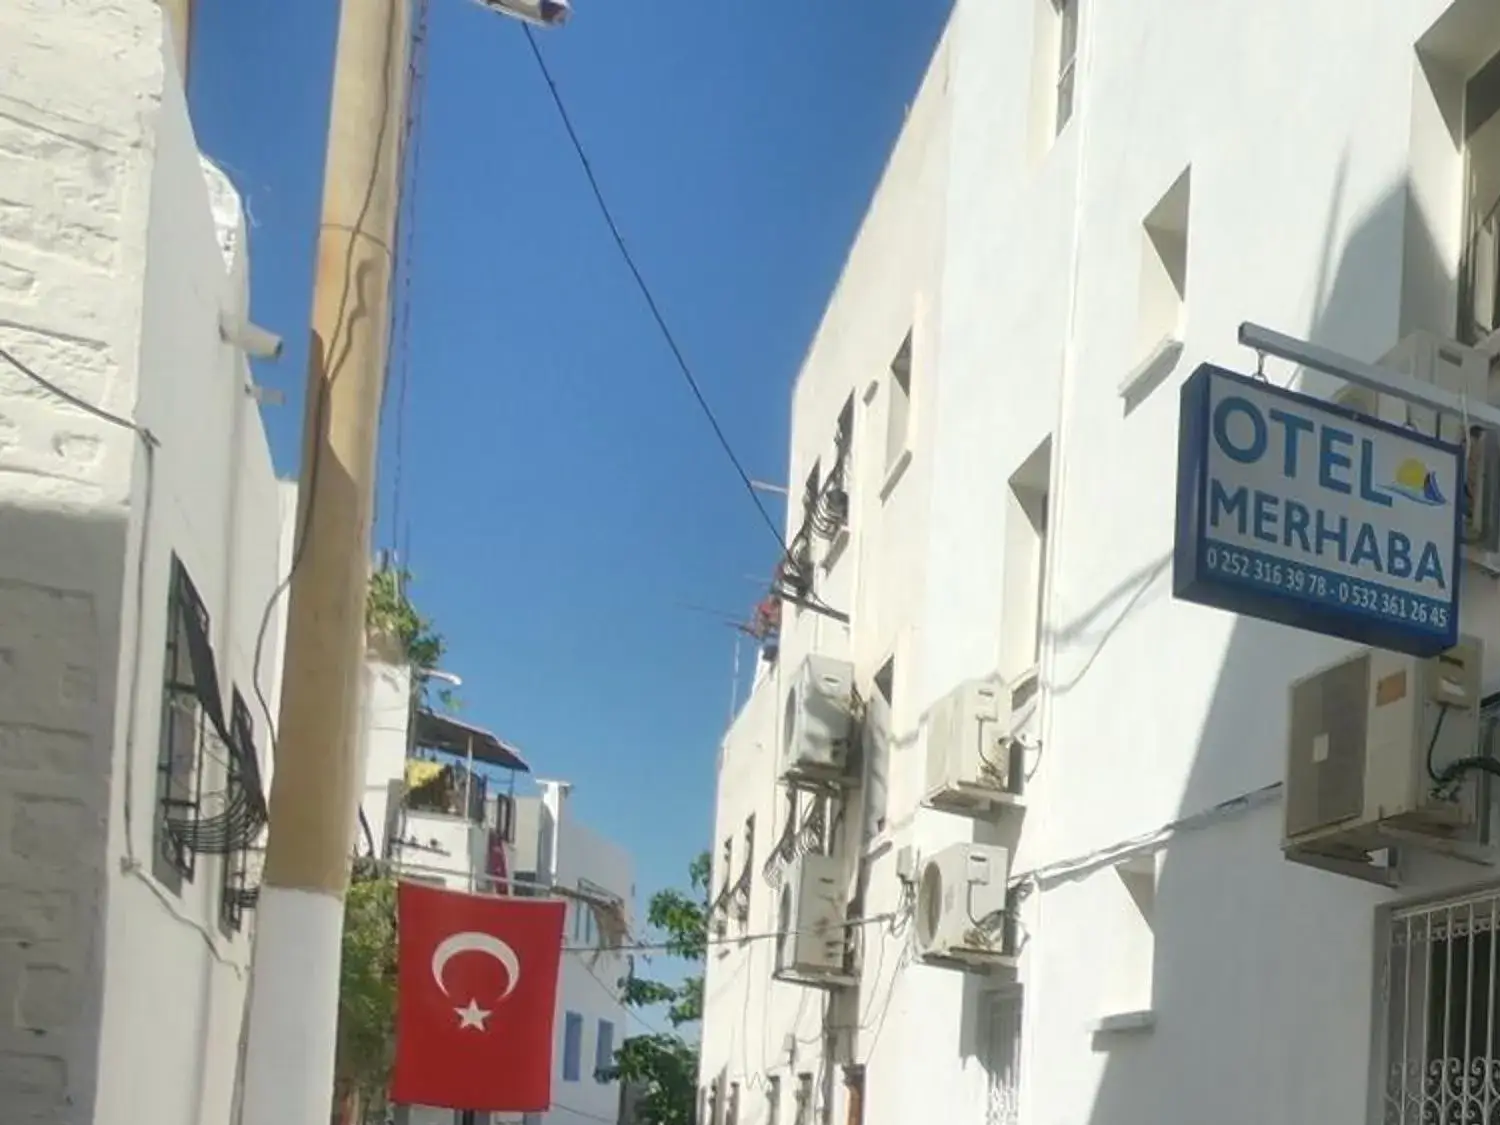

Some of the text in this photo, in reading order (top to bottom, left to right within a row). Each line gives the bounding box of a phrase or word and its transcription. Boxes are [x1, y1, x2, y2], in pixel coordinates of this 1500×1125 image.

[1213, 395, 1393, 508] OTEL
[1206, 547, 1218, 570] 0
[1220, 551, 1250, 578] 252
[1253, 559, 1283, 586] 316
[1285, 567, 1306, 593] 39
[1308, 573, 1328, 597] 78
[1339, 581, 1349, 603] 0
[1351, 585, 1378, 611] 532
[1381, 593, 1407, 618] 361
[1410, 600, 1428, 623] 26
[1430, 607, 1448, 628] 45
[1209, 477, 1446, 590] MERHABA
